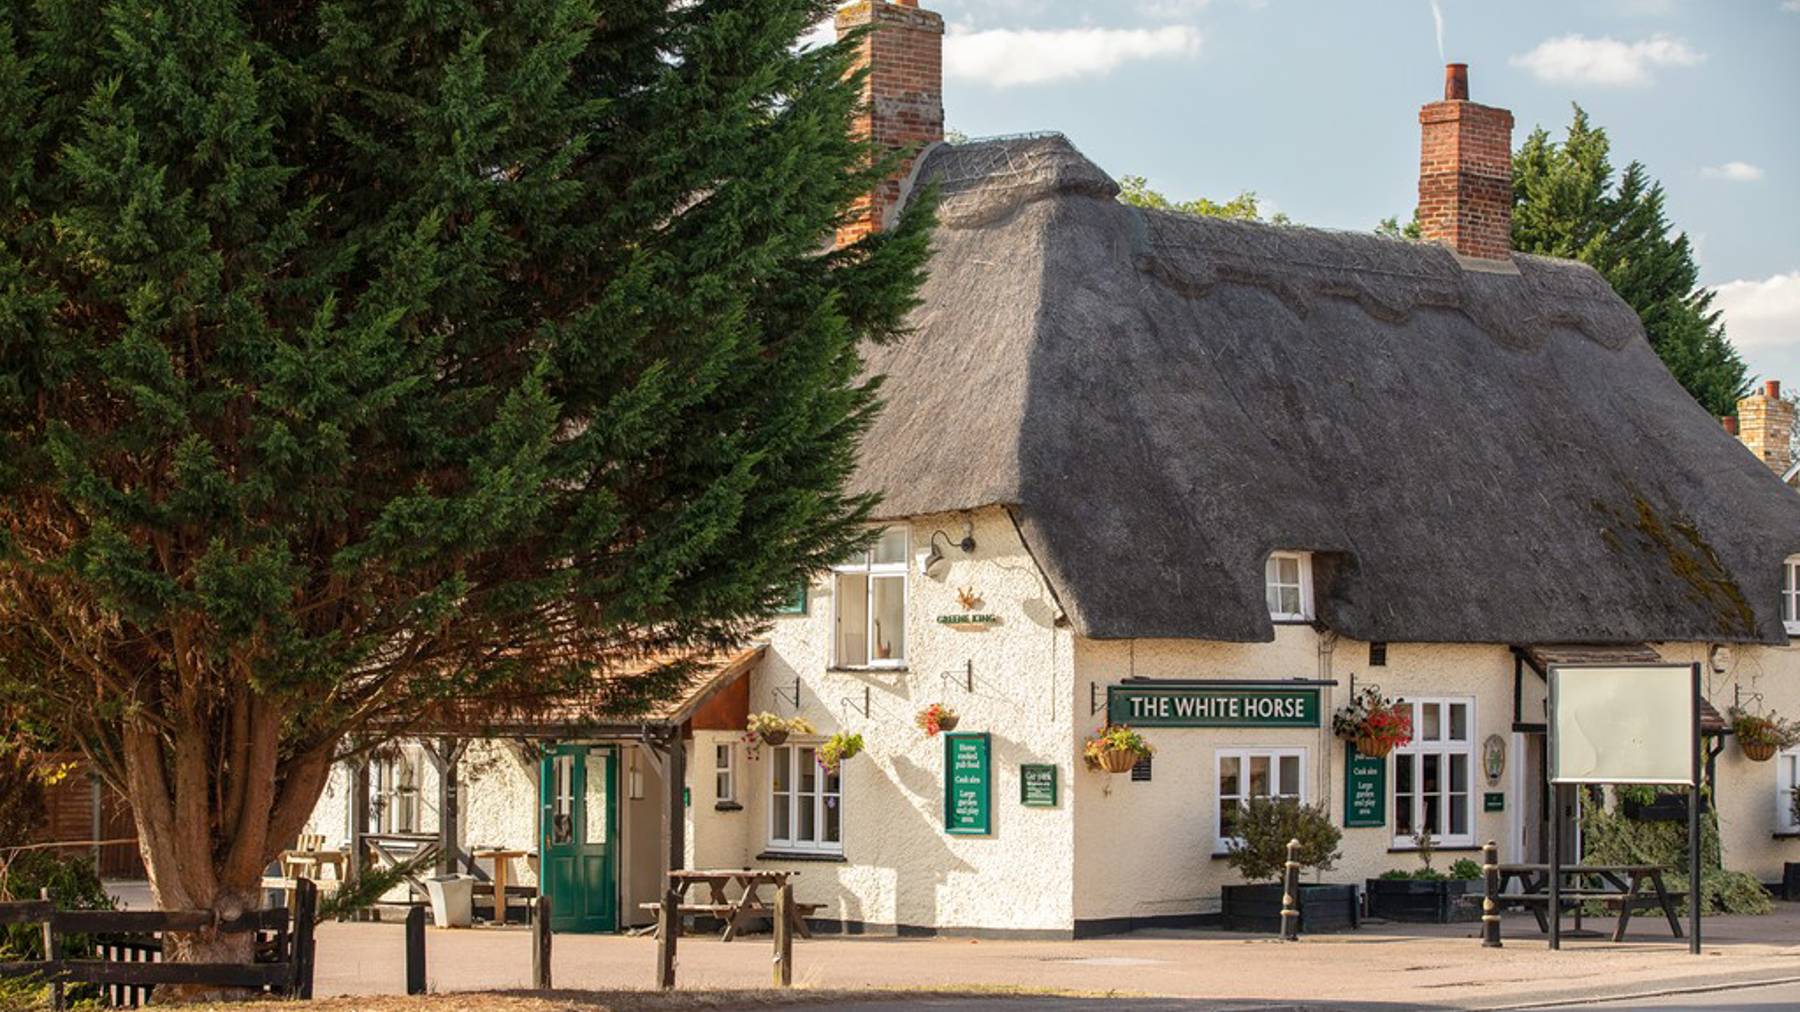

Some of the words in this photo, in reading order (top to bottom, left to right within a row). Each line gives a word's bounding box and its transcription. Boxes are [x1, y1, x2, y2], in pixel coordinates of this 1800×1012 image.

[1130, 697, 1169, 717] THE
[1174, 697, 1239, 718] WHITE
[1244, 698, 1305, 718] HORSE
